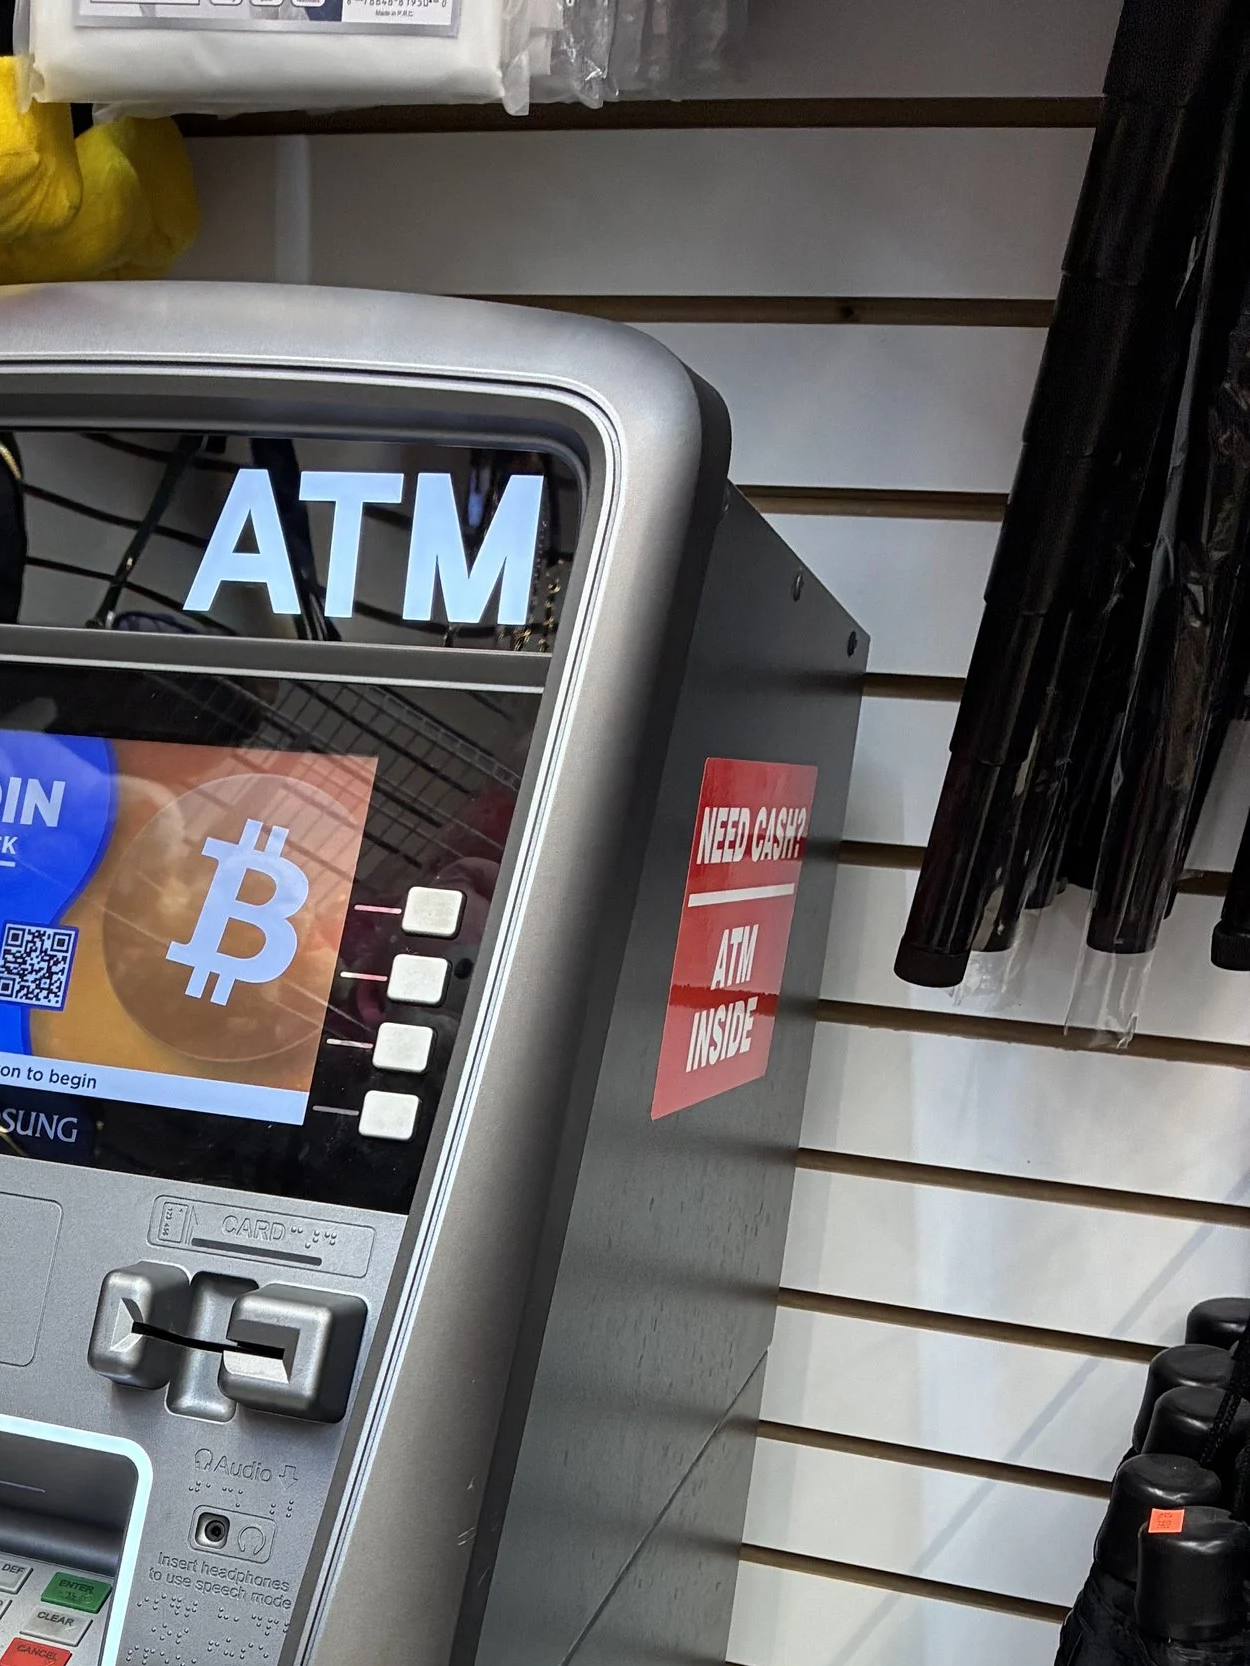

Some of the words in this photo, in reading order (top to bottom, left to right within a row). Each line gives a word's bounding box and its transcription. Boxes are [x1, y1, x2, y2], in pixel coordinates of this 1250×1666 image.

[183, 468, 543, 625] ATM
[696, 806, 750, 865] NEED
[751, 806, 807, 863] CASH?
[710, 924, 759, 990] ATM
[685, 996, 758, 1073] INSIDE
[27, 1066, 43, 1082] to
[49, 1071, 97, 1091] begin
[222, 1214, 286, 1242] CARD
[213, 1455, 272, 1482] Audio
[2, 1563, 25, 1575] DEF
[158, 1551, 198, 1573] Insert
[201, 1560, 290, 1592] headphones
[58, 1579, 94, 1594] ENTER
[149, 1567, 162, 1581] to
[166, 1573, 191, 1588] use
[195, 1580, 246, 1601] speech
[251, 1591, 291, 1610] mode
[36, 1610, 74, 1627] CLEAR
[16, 1644, 59, 1660] CANCEL
